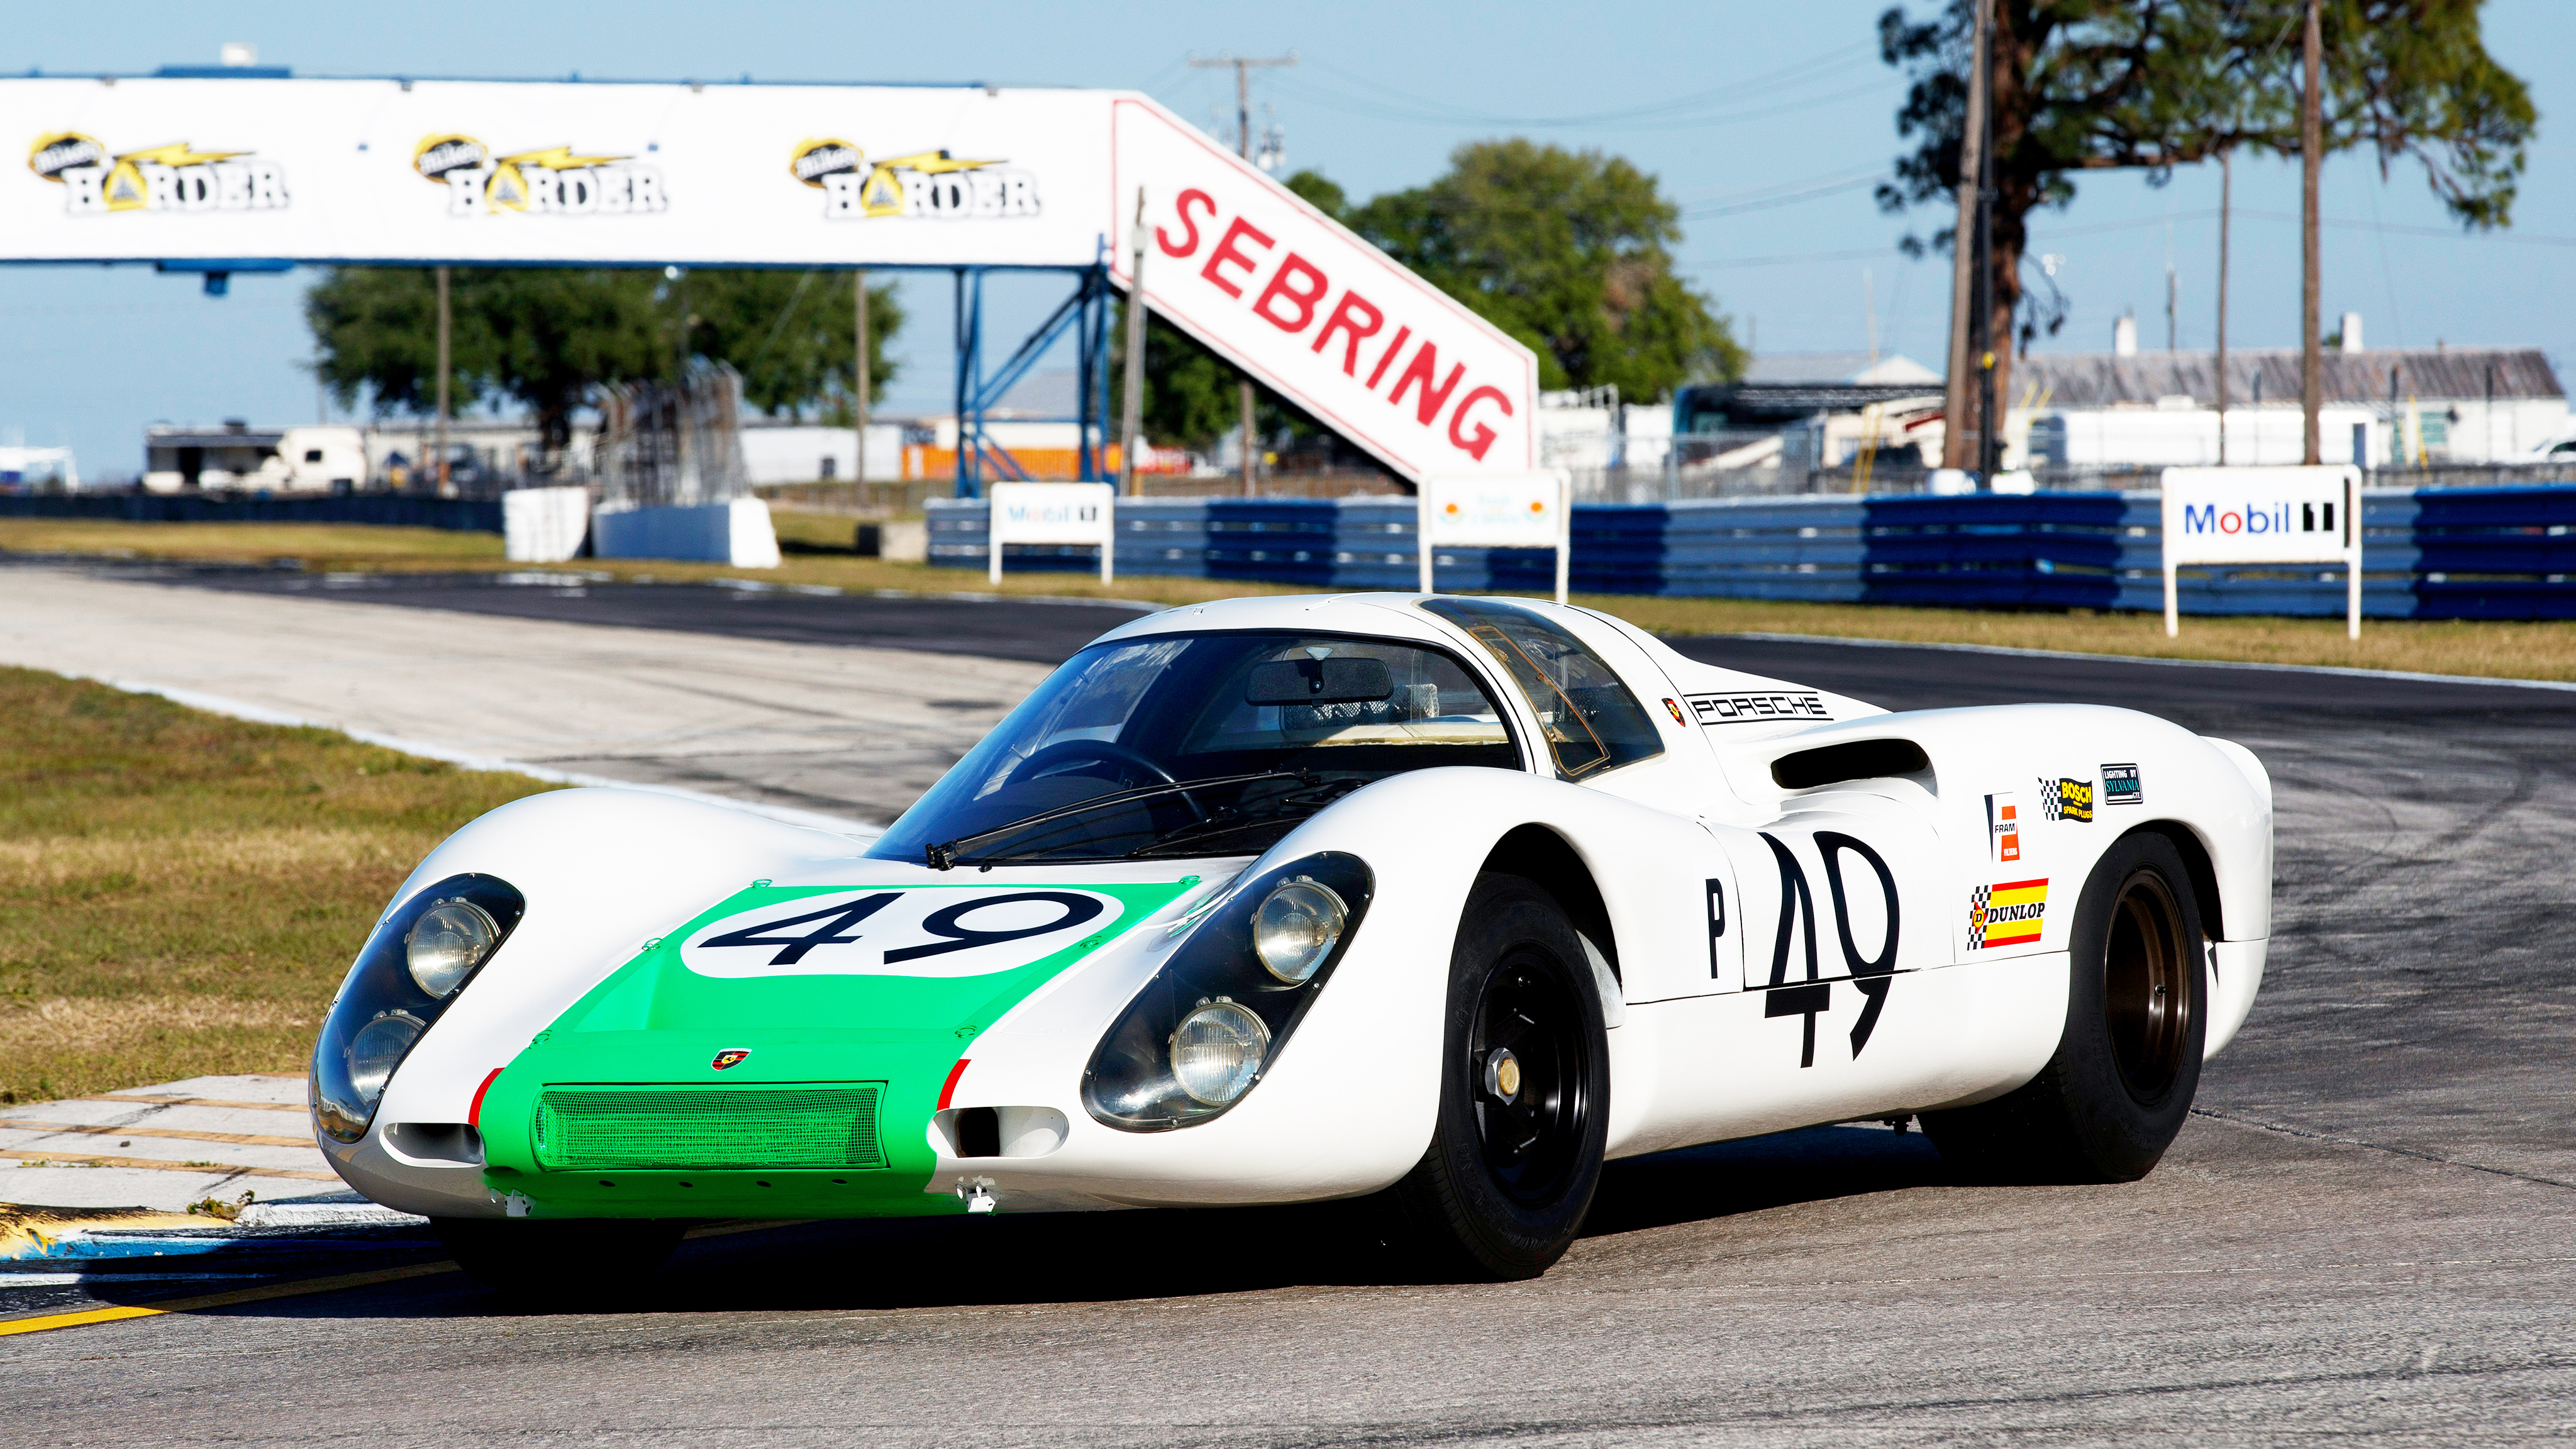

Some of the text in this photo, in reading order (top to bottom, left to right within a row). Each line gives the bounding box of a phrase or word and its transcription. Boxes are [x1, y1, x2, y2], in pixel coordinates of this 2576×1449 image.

[1156, 188, 1513, 462] SEBRING
[2185, 502, 2331, 533] Mobil 1
[1690, 697, 1827, 718] PORSCHE
[2104, 769, 2136, 779] LIGHTING BY
[2062, 782, 2092, 804] BOSCH
[2106, 780, 2140, 792] SYLVANIA
[2063, 806, 2092, 819] SPARK PLUGS
[1995, 823, 2015, 833] FRAM
[1975, 913, 1982, 923] D
[1988, 902, 2045, 923] DUNLOP
[696, 891, 1104, 966] 49
[1706, 878, 1725, 979] P
[1756, 830, 1900, 1069] 49
